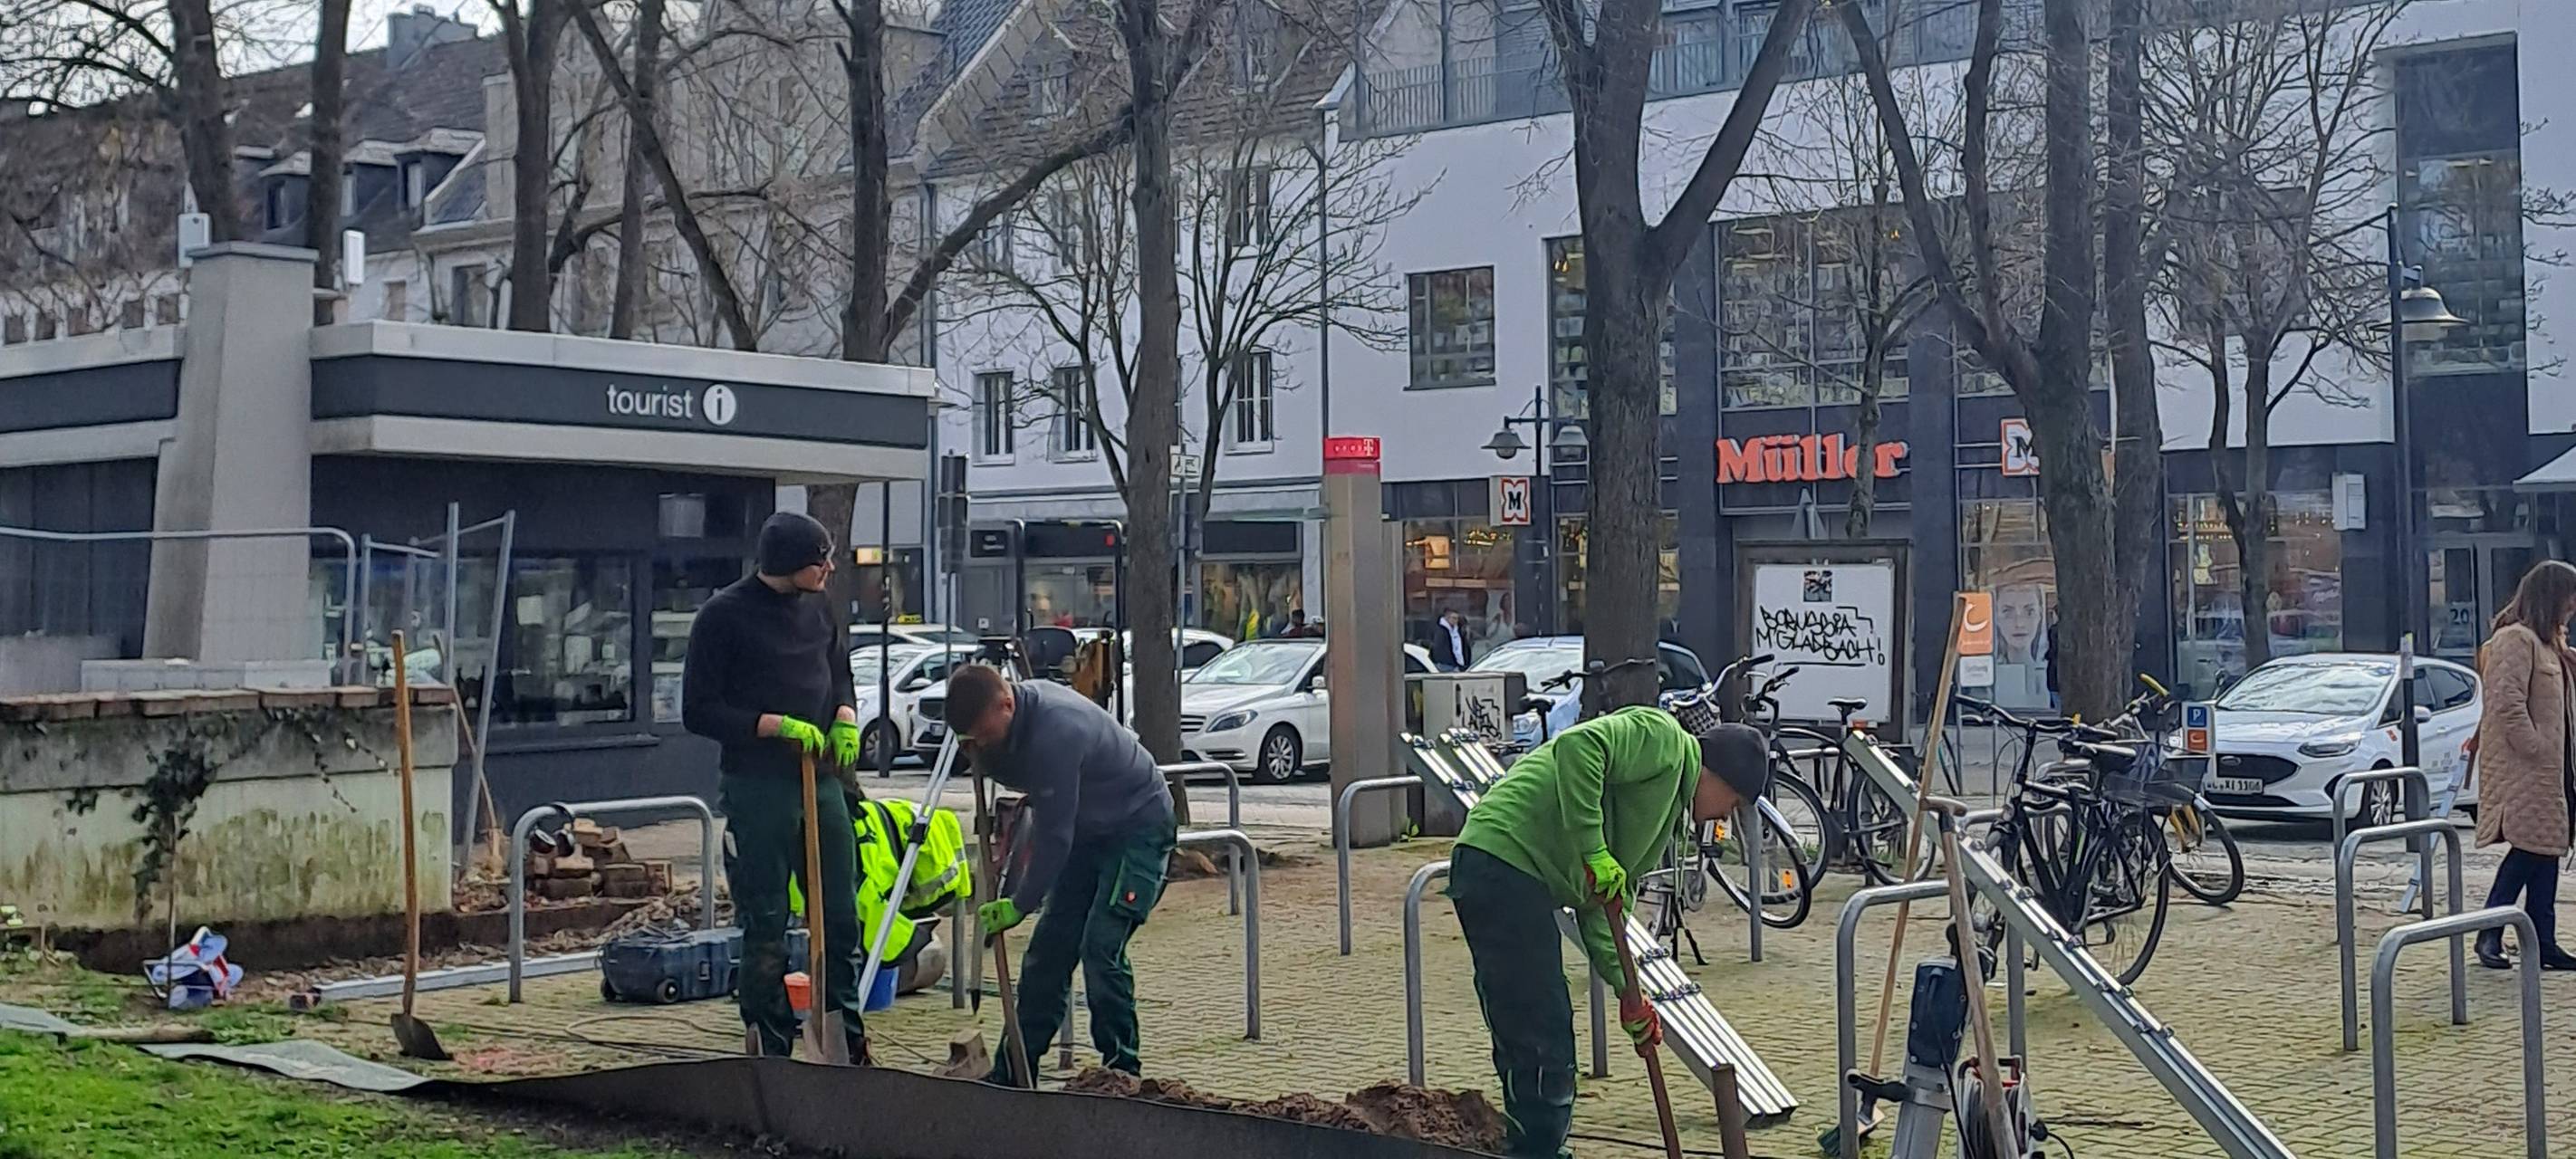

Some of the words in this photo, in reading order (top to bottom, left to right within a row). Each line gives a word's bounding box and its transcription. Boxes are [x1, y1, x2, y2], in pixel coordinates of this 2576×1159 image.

[607, 383, 694, 418] tourist
[1507, 491, 1523, 511] M
[2449, 608, 2470, 625] 20
